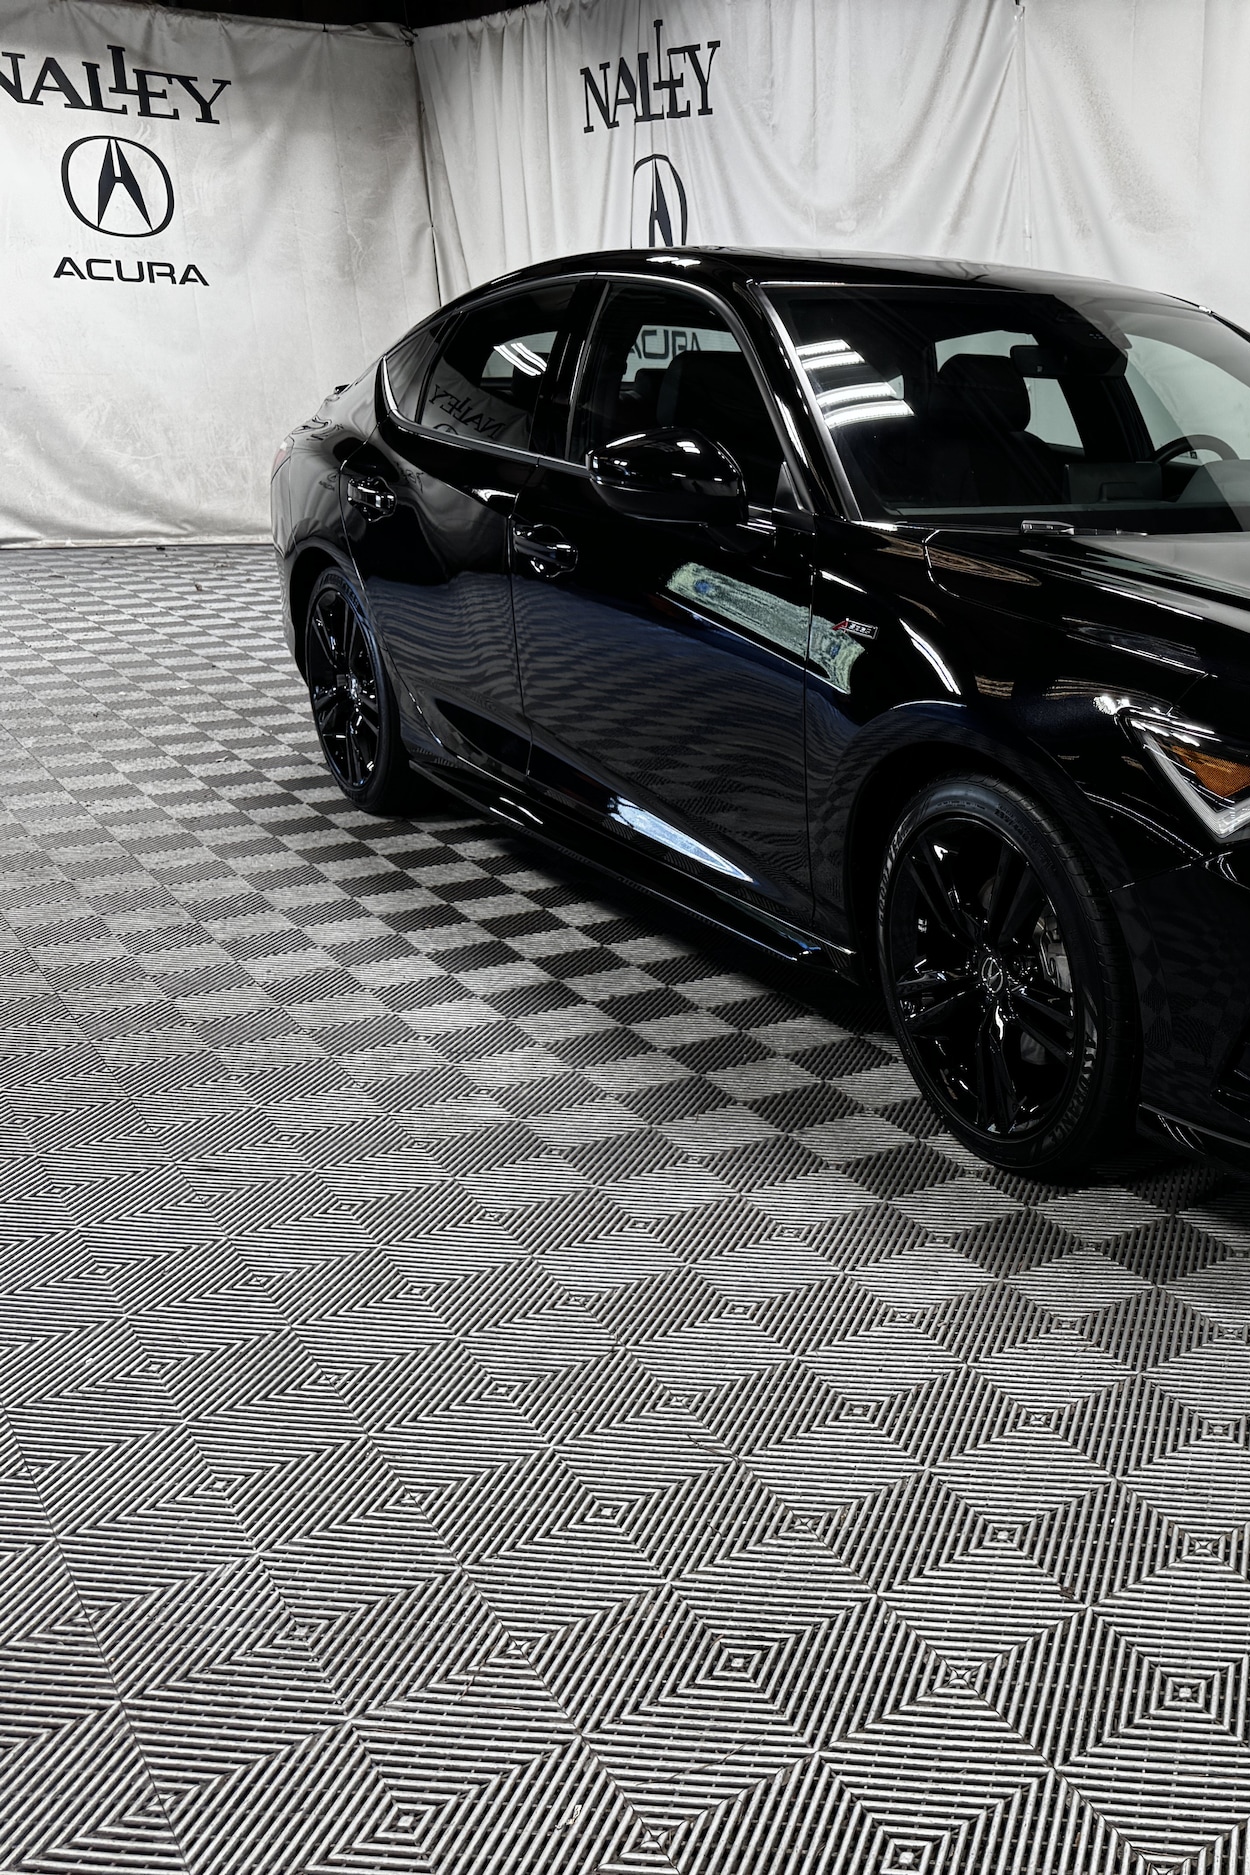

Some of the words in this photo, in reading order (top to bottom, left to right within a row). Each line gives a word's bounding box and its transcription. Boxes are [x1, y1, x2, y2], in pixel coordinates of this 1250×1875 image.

[0, 45, 232, 125] NALLEY
[580, 19, 721, 134] NALLEY
[53, 256, 210, 287] ACURA
